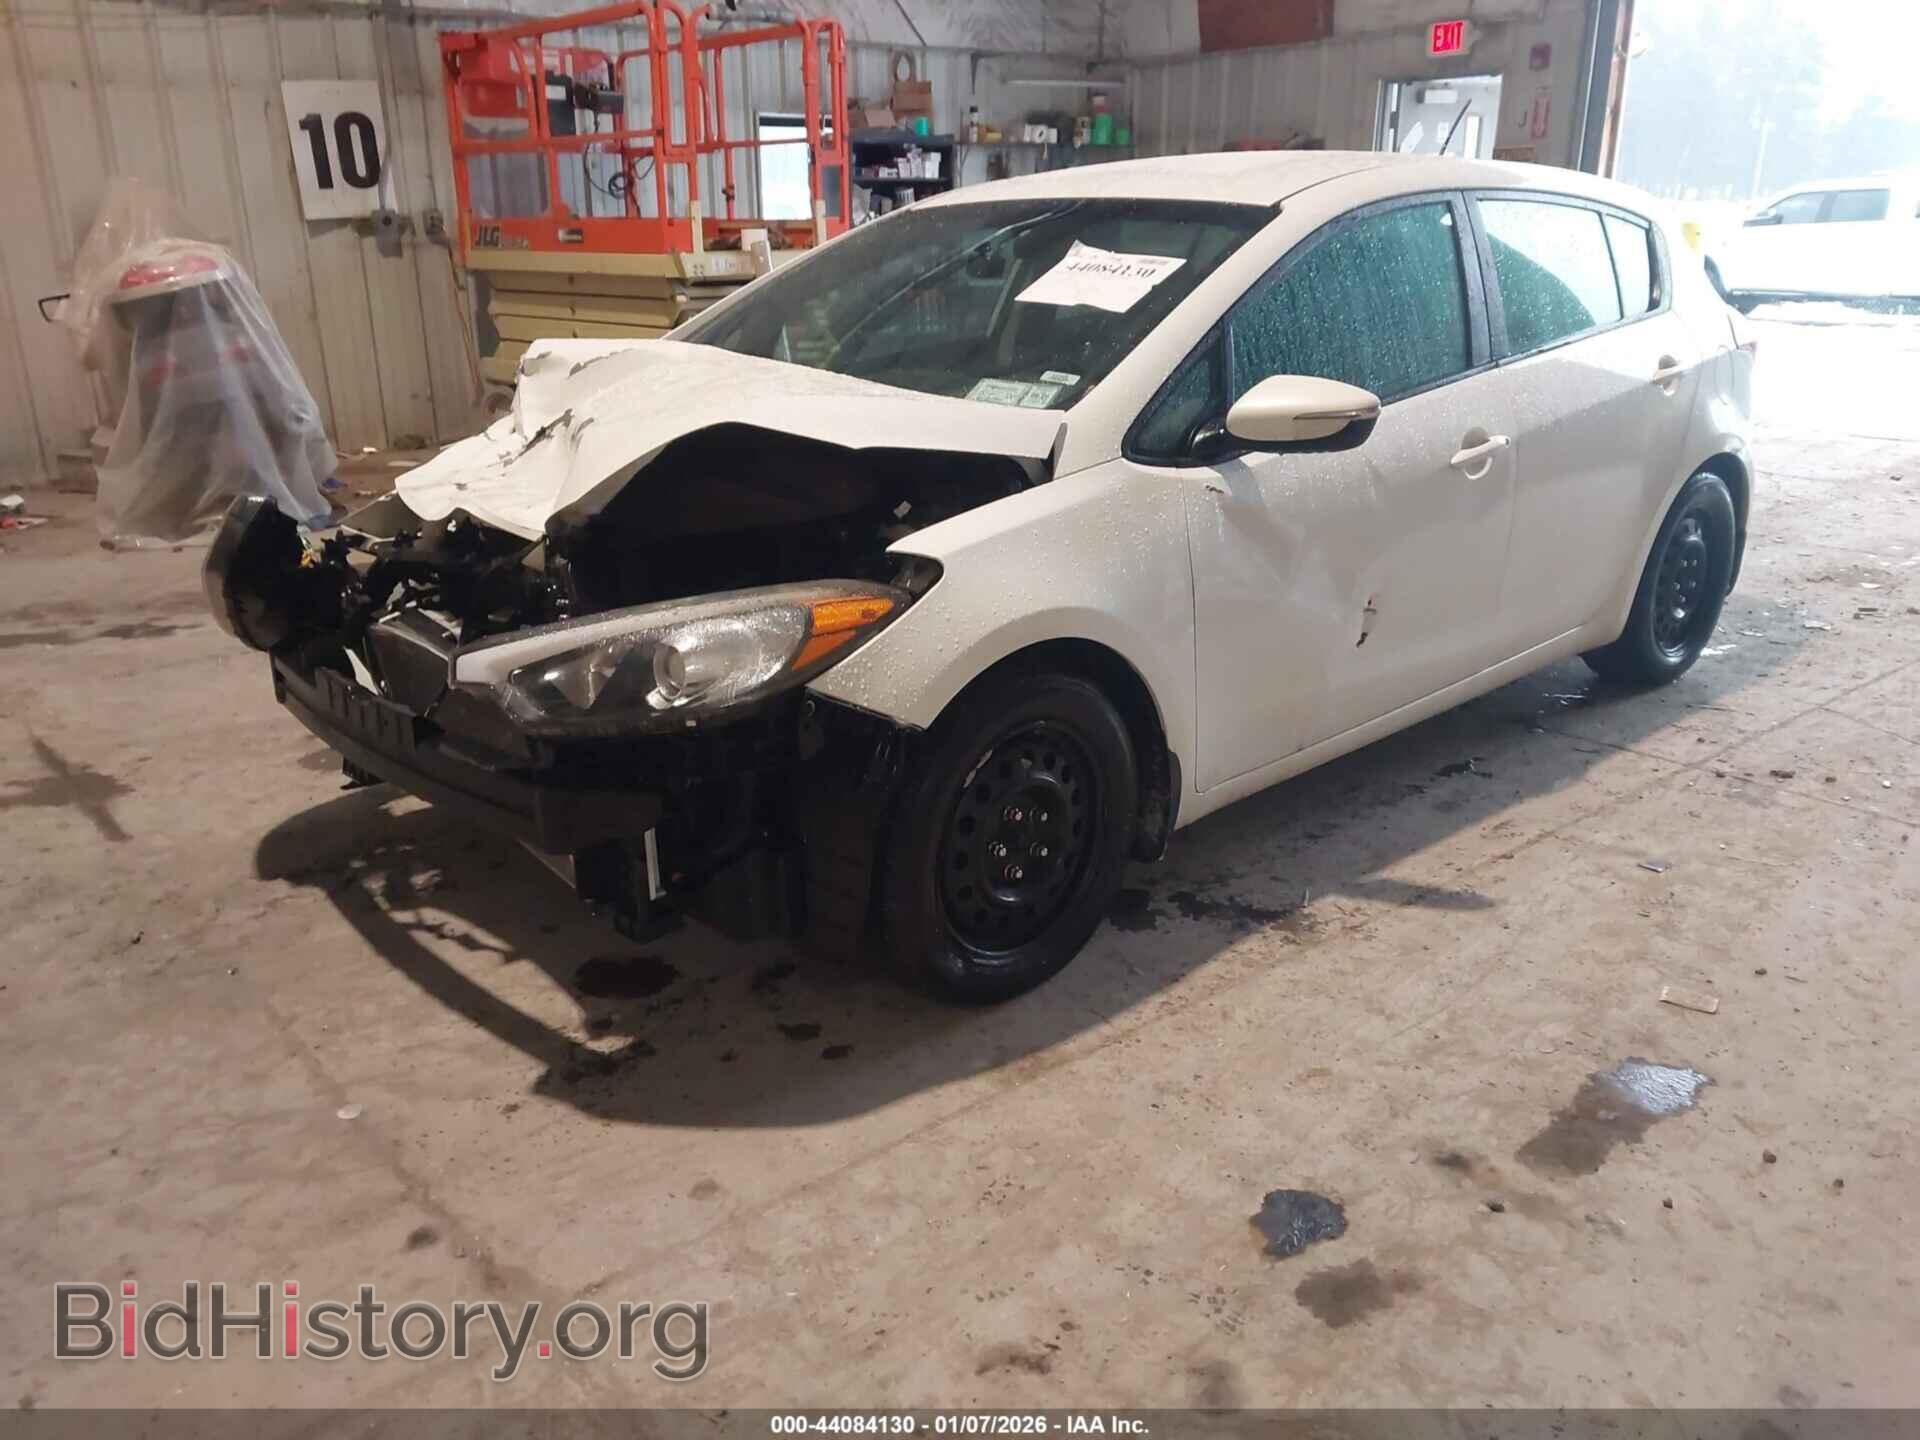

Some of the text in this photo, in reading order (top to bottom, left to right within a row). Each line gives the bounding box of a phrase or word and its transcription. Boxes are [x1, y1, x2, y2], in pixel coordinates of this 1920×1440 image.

[1432, 21, 1464, 53] EXIT
[299, 111, 381, 189] 10
[474, 225, 501, 248] JLG
